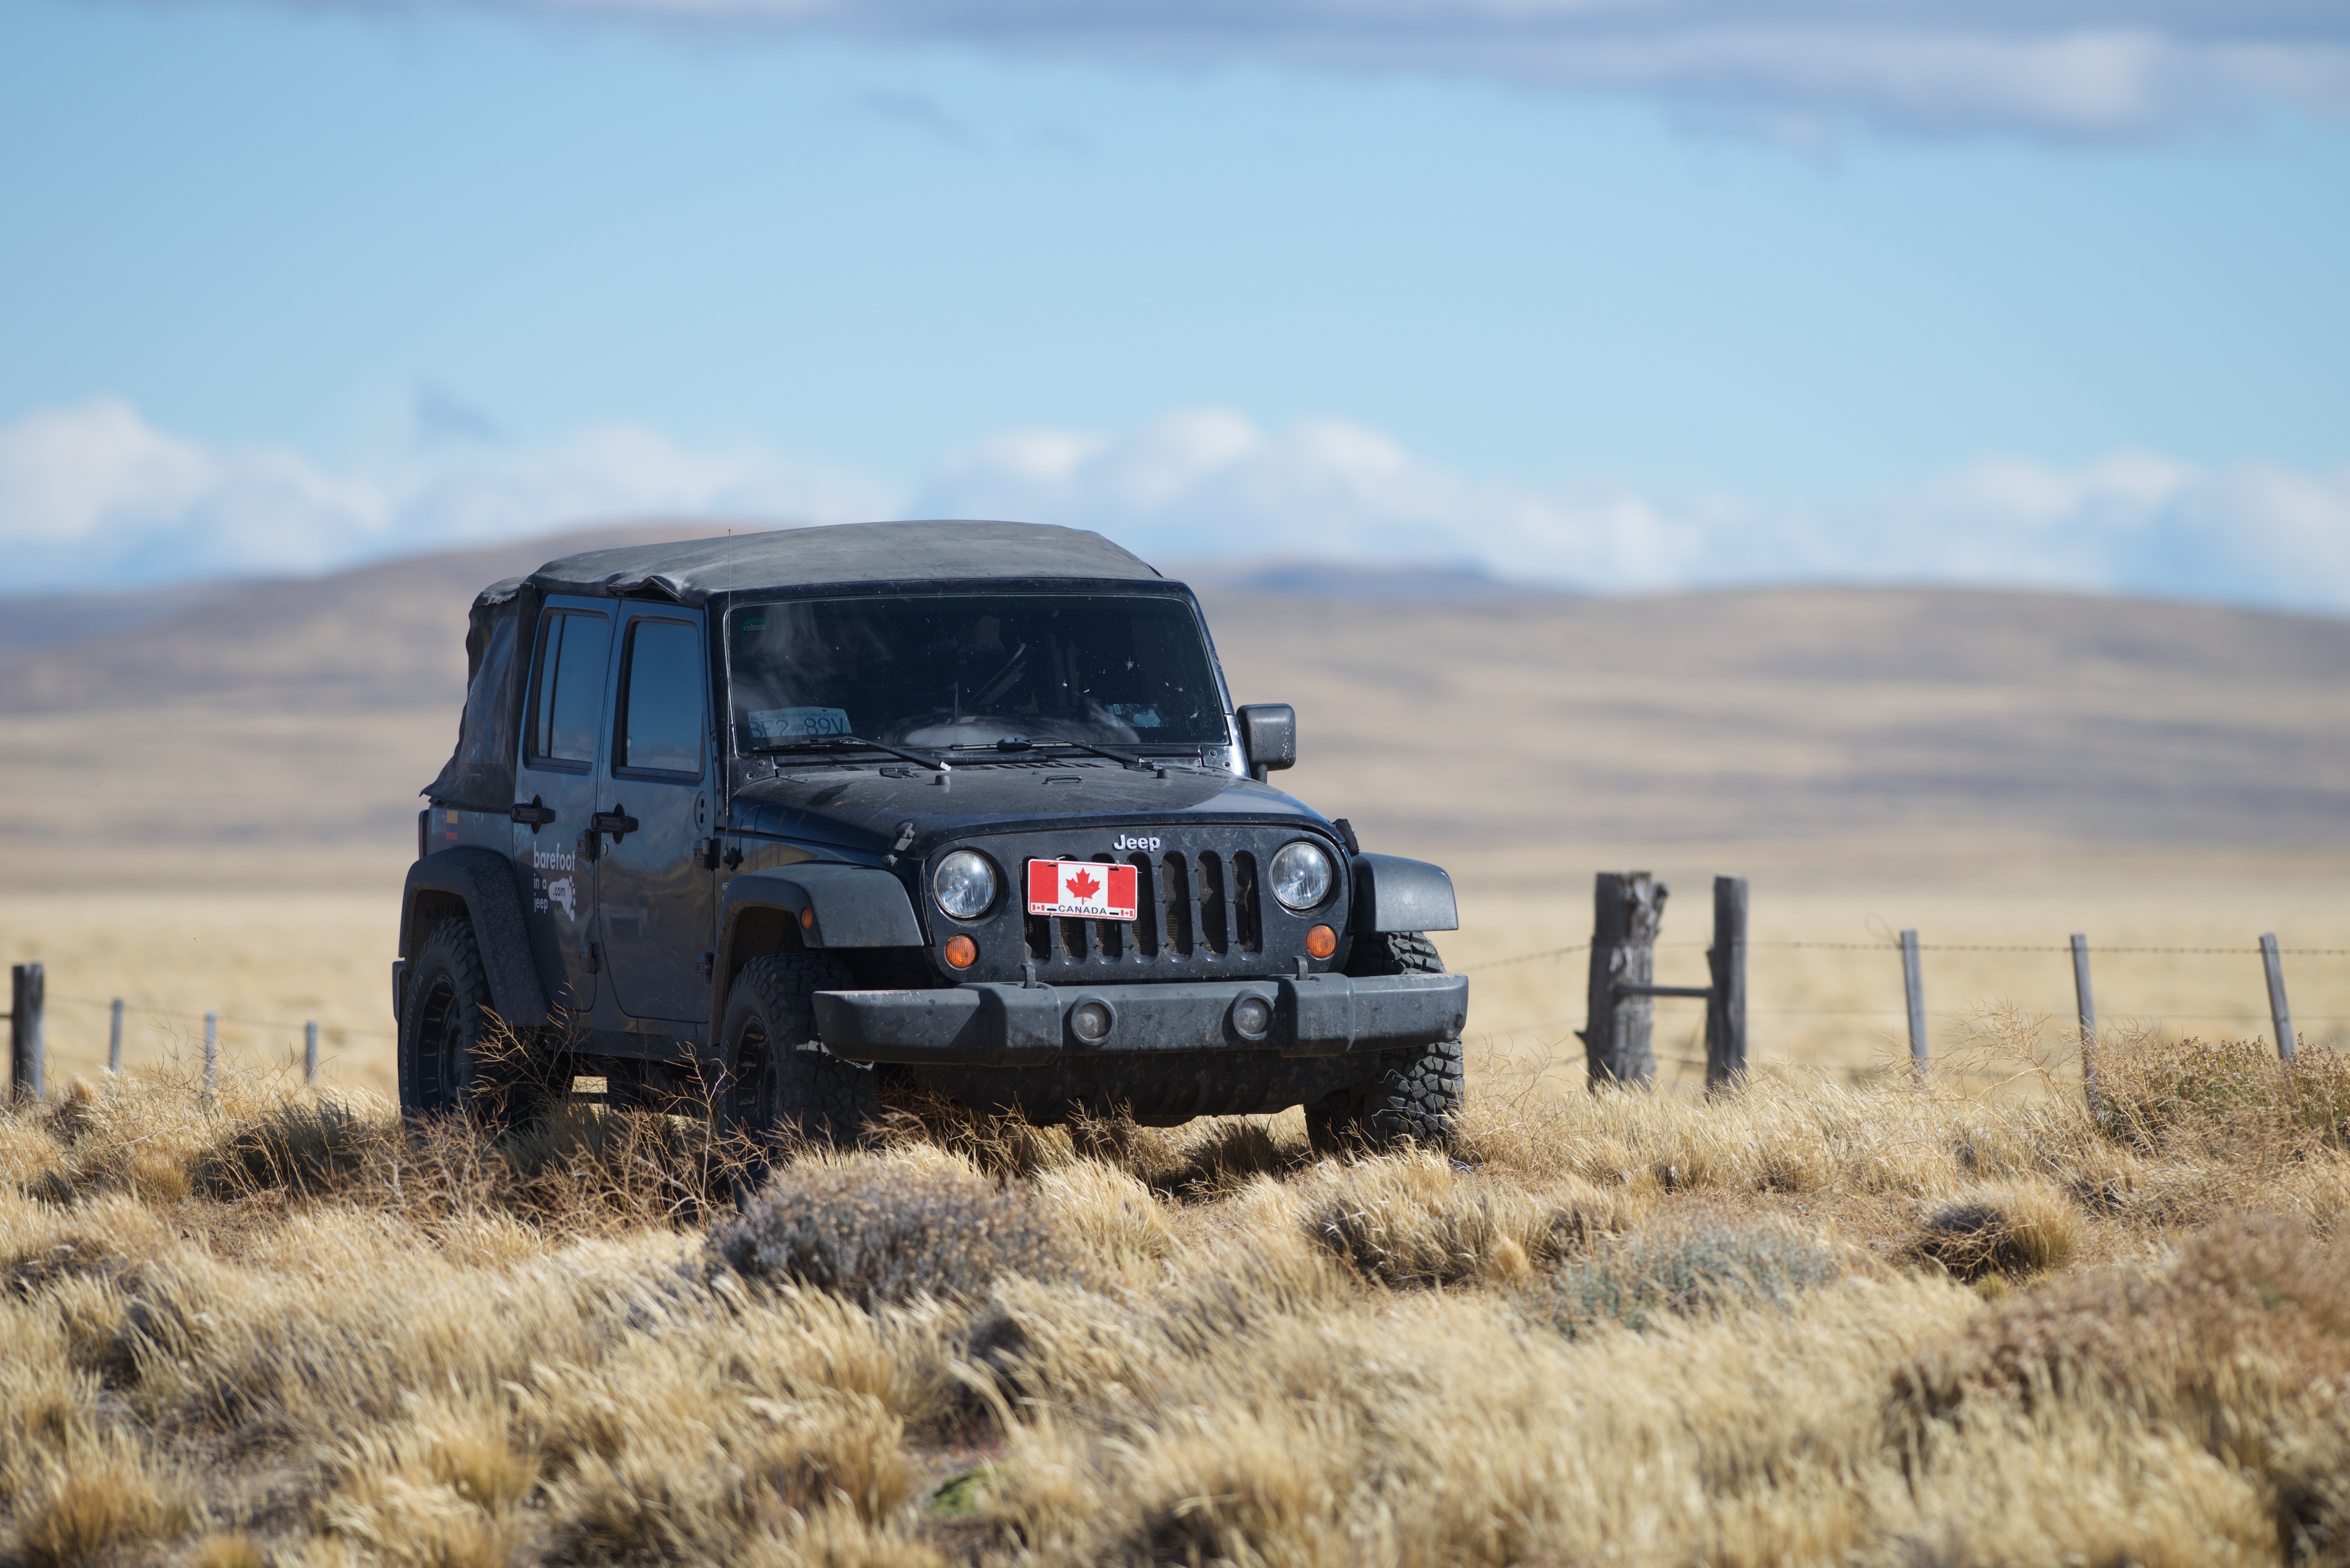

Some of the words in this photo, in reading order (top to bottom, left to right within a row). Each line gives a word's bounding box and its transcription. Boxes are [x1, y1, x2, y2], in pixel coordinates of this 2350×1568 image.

[804, 718, 843, 735] 89V
[1113, 834, 1160, 852] Jeep
[534, 841, 575, 871] barefoot
[534, 873, 540, 889] in
[542, 879, 547, 889] a
[553, 887, 565, 897] .com
[534, 892, 548, 914] jeep
[1058, 905, 1107, 914] CANADA
